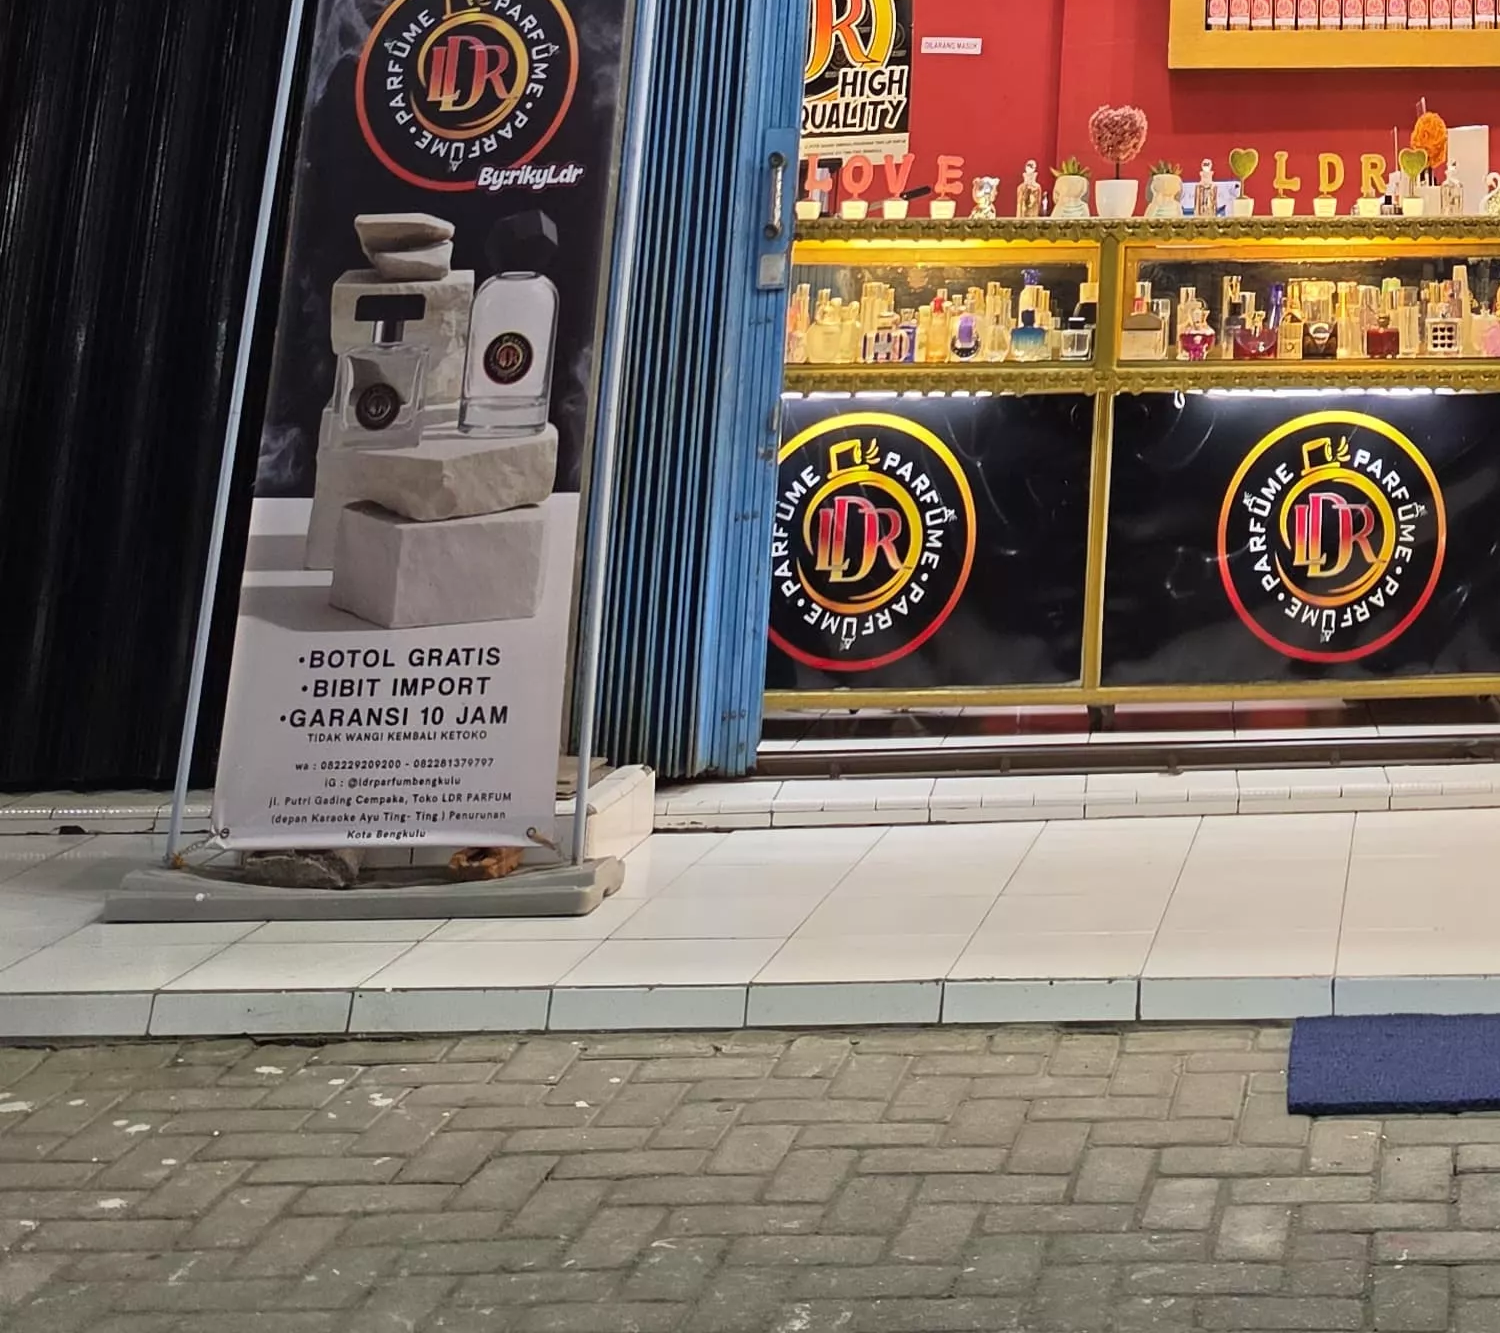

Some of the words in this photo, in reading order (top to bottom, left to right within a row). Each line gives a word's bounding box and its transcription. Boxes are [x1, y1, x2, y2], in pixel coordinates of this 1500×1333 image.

[427, 35, 511, 111] LDR
[839, 66, 908, 99] HIGH
[814, 495, 904, 582] LDR
[1293, 492, 1378, 577] LDR
[309, 649, 395, 669] BOTOL
[408, 647, 501, 667] GRATIS
[313, 678, 380, 698] BIBIT
[391, 676, 491, 697] IMPORT
[290, 706, 409, 728] GARANSI
[420, 706, 445, 727] 10
[456, 704, 509, 726] JAM
[307, 733, 341, 743] TIDAK
[345, 732, 384, 742] WANGI
[387, 731, 437, 741] KEMBALI
[440, 730, 487, 740] KETOKO
[284, 795, 311, 807] Putri
[314, 794, 352, 807] Gading
[355, 794, 408, 807] Cempaka,
[412, 792, 439, 804] Toko
[442, 792, 463, 804] LDR
[466, 791, 512, 803] PARFUM
[311, 813, 356, 824] Karaoke
[359, 812, 380, 825] Ayu
[415, 811, 438, 824] Ting
[449, 809, 506, 821] Penurunan
[376, 828, 426, 841] Bengkulu
